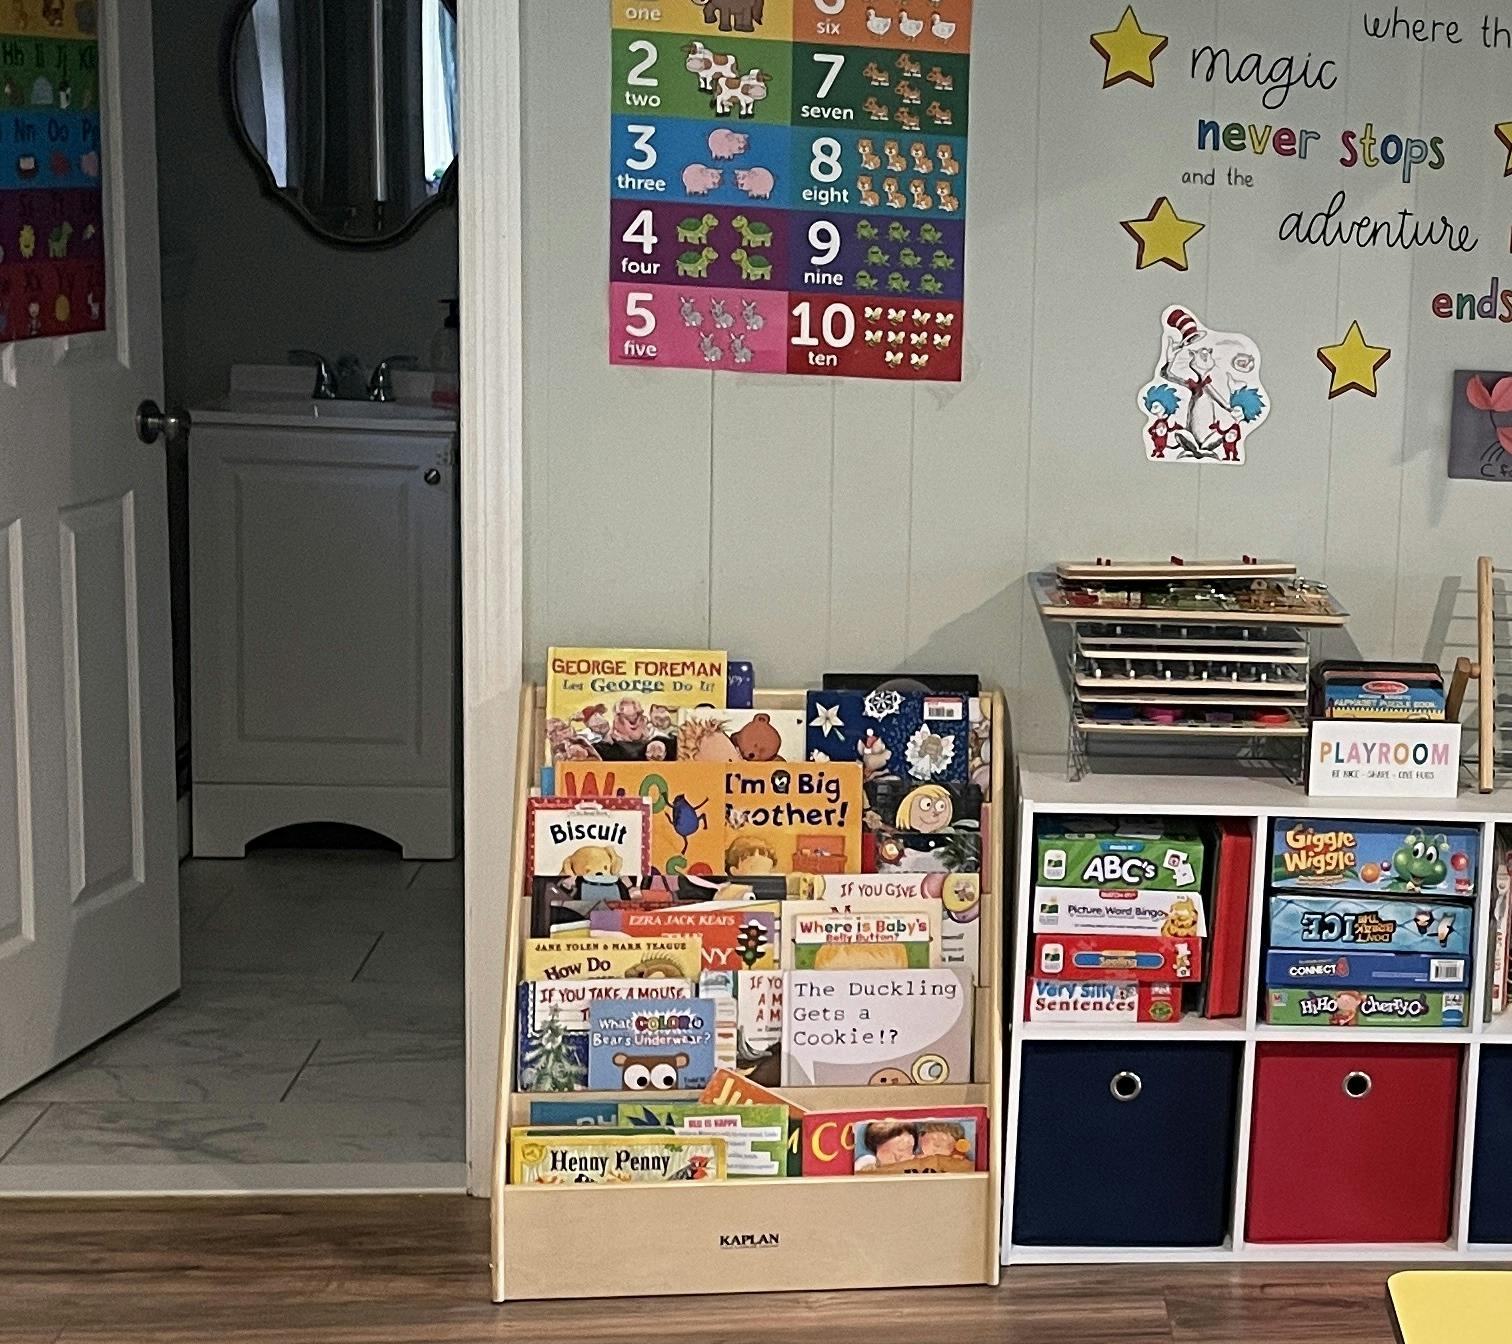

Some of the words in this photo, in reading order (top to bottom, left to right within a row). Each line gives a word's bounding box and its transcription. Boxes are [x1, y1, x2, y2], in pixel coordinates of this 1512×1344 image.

[626, 7, 661, 21] one
[817, 20, 840, 35] six
[1363, 7, 1462, 44] where
[628, 40, 658, 86] 2
[814, 54, 845, 99] 7
[1191, 46, 1338, 110] magic
[625, 92, 660, 107] two
[801, 105, 854, 121] seven
[627, 125, 657, 170] 3
[1198, 118, 1321, 159] never
[1340, 123, 1445, 184] stops
[810, 137, 843, 182] 8
[617, 175, 666, 192] three
[1182, 170, 1215, 186] and
[1228, 168, 1253, 187] the
[802, 187, 849, 205] eight
[1279, 190, 1479, 253] adventure
[623, 210, 658, 253] 4
[808, 220, 841, 265] 9
[622, 259, 660, 275] four
[804, 271, 843, 286] nine
[626, 293, 656, 337] 5
[791, 302, 855, 347] 10
[624, 341, 658, 358] five
[809, 352, 838, 367] ten
[1481, 464, 1495, 477] C
[552, 659, 626, 676] GEORGE
[635, 661, 721, 677] FOREMAN
[590, 678, 664, 693] George
[672, 681, 693, 691] Do
[1320, 742, 1449, 765] PLAYROOM
[725, 773, 765, 795] I'm
[799, 772, 840, 803] Big
[550, 821, 627, 845] Biscuit
[1286, 828, 1356, 851] Giggle
[1083, 855, 1156, 883] ABC's
[1283, 850, 1356, 874] Wiggle
[841, 883, 854, 896] IF
[859, 882, 882, 897] YOU
[885, 883, 917, 897] GIVE
[629, 915, 661, 925] EZRA
[665, 915, 696, 925] JACK
[700, 915, 735, 924] KEATS
[1068, 905, 1102, 916] Picture
[1106, 906, 1132, 916] Word
[1136, 907, 1165, 922] Bingo
[800, 921, 852, 933] Where
[857, 917, 870, 932] is
[876, 919, 926, 935] Baby's
[1303, 913, 1355, 942] ICE
[535, 943, 561, 951] JANE
[544, 963, 581, 980] How
[587, 957, 611, 972] Do
[1289, 965, 1336, 975] CONNECT
[750, 976, 763, 990] IF
[794, 983, 835, 998] The
[849, 981, 957, 999] Duckling
[1036, 983, 1075, 1000] Very
[1080, 983, 1115, 1000] Silly
[539, 988, 558, 1003] IF
[559, 988, 585, 1002] YOU
[589, 988, 623, 1000] TAKE
[626, 987, 635, 1000] A
[638, 987, 684, 1000] MOUSE
[758, 994, 765, 1005] A
[1035, 997, 1134, 1011] Sentences
[756, 1009, 763, 1022] A
[794, 1008, 845, 1021] Gets
[859, 1010, 869, 1020] a
[599, 1019, 630, 1029] What
[634, 1032, 711, 1046] Underwear?
[794, 1029, 899, 1046] Cookie!?
[551, 1150, 608, 1176] Henny
[615, 1150, 670, 1176] Penny
[720, 1234, 779, 1246] KAPLAN
